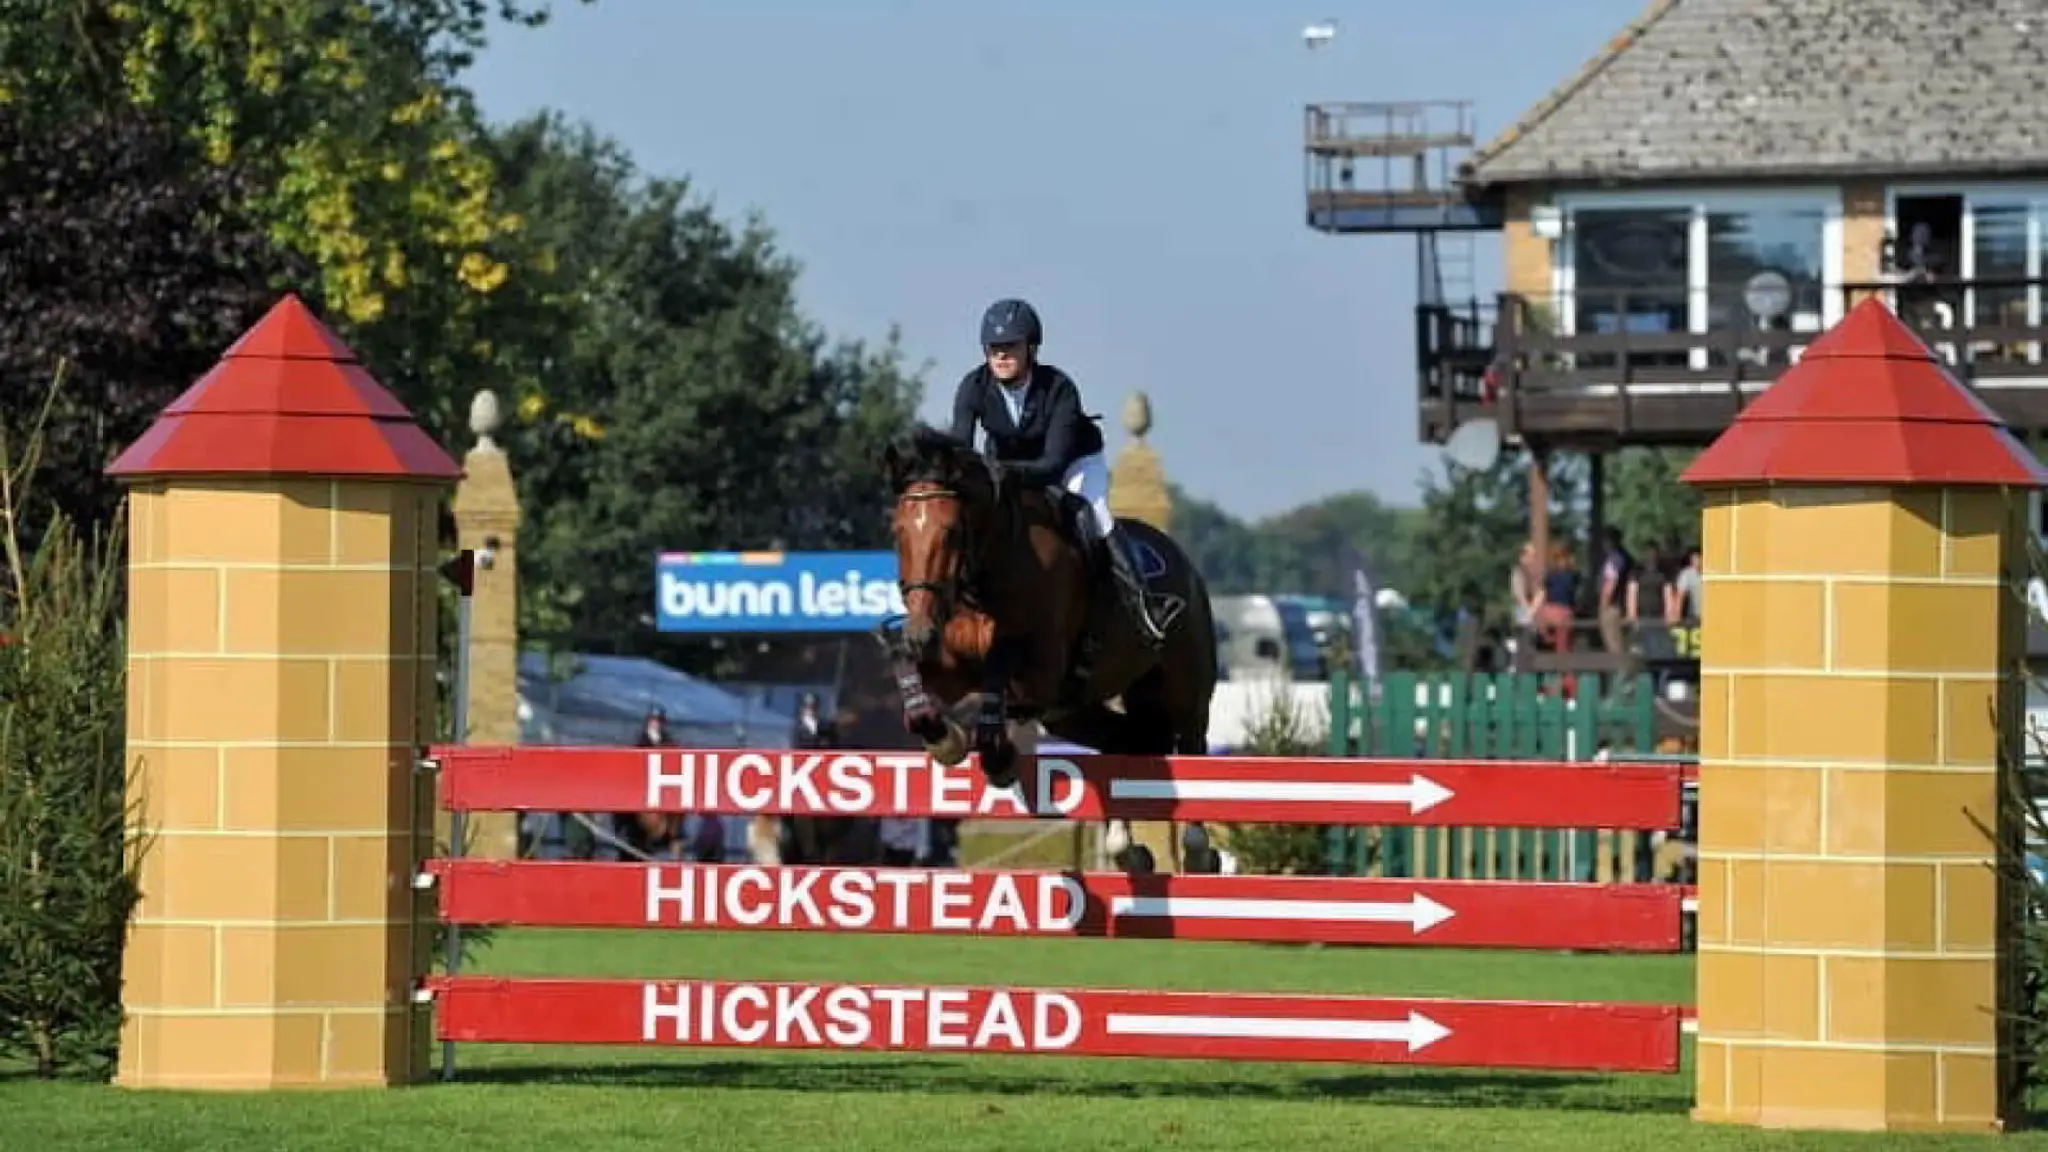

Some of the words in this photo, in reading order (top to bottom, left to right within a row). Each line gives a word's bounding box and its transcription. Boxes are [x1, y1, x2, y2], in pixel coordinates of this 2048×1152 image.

[660, 570, 794, 616] bunn
[645, 866, 1086, 930] HICKSTEAD
[643, 982, 1082, 1049] HICKSTEAD
